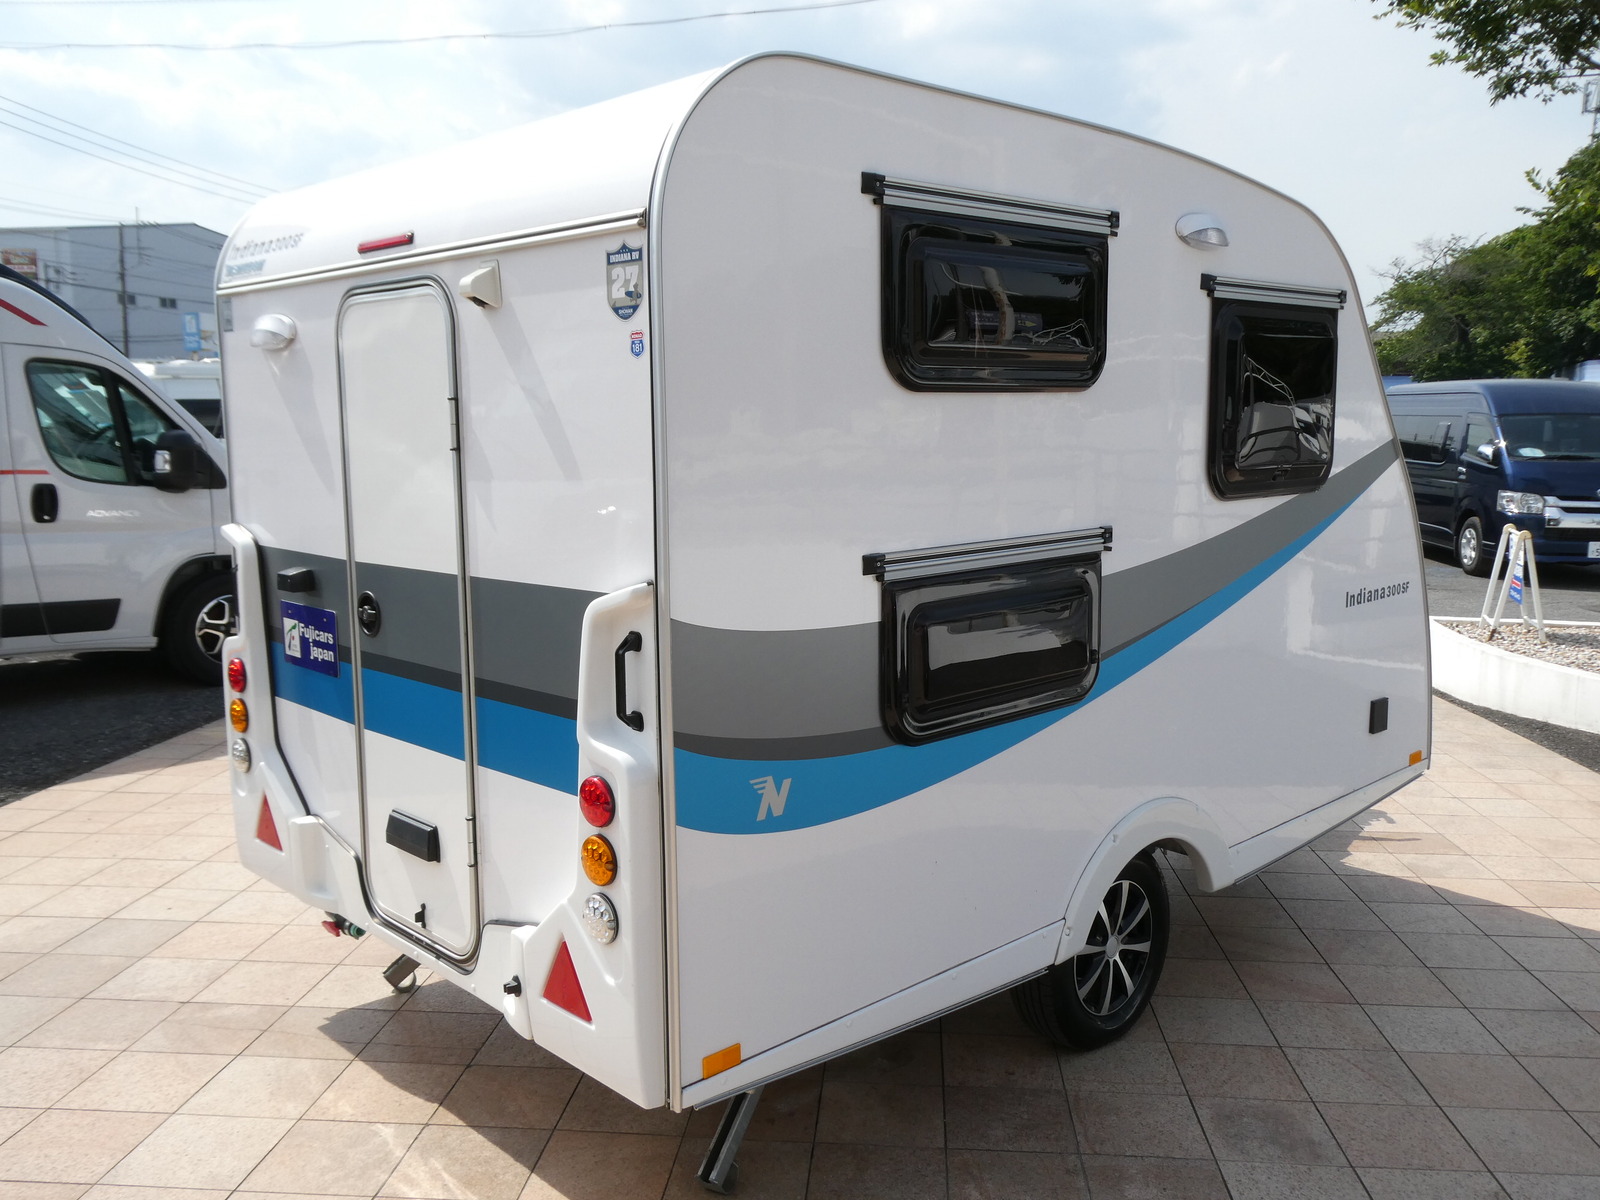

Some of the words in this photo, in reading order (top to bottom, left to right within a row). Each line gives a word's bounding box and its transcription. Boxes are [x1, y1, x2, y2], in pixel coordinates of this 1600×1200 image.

[609, 252, 631, 263] INDIANA
[631, 251, 640, 260] RV
[611, 265, 639, 299] 27
[632, 343, 643, 353] 181
[1345, 581, 1410, 608] Indiana300SF
[299, 622, 334, 645] Fujicars
[310, 643, 335, 662] japan
